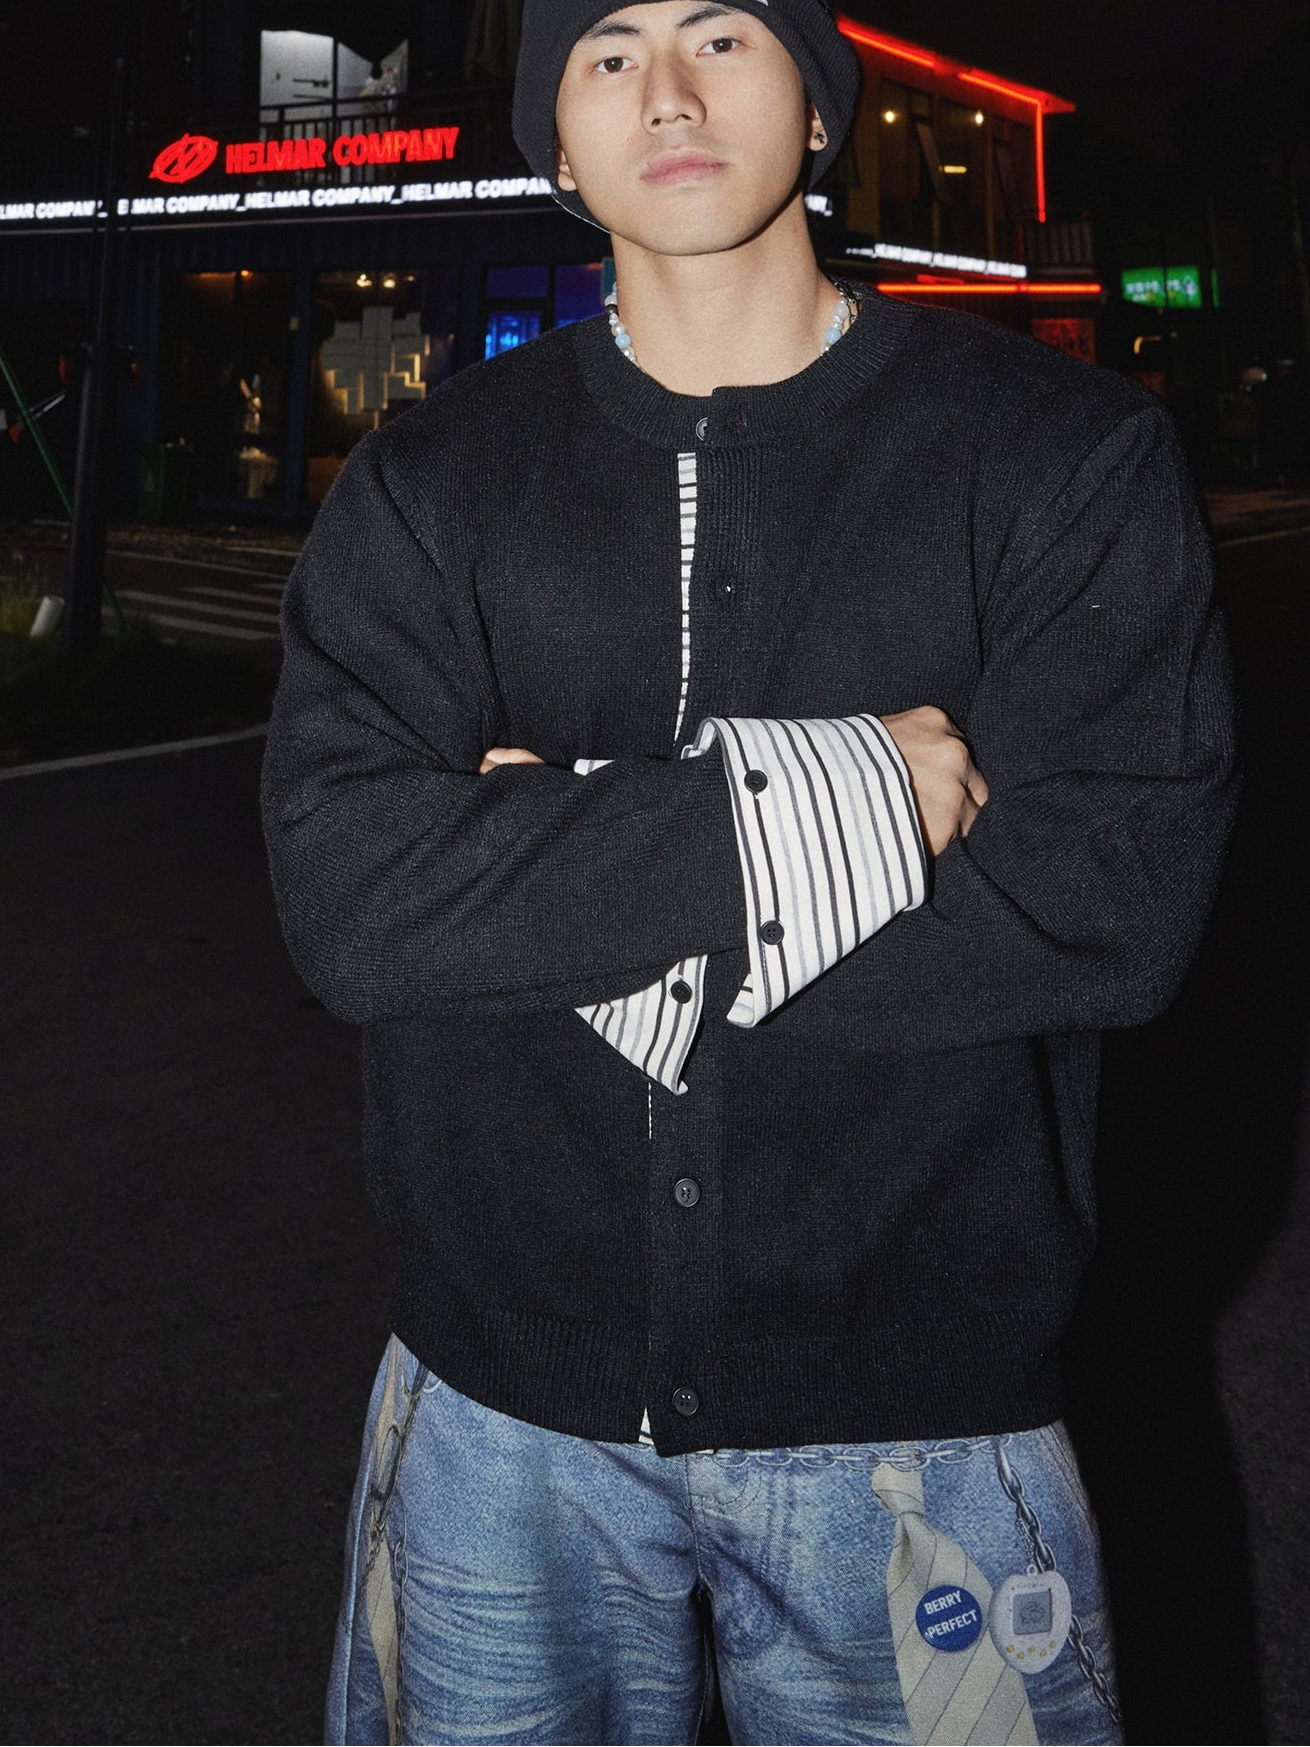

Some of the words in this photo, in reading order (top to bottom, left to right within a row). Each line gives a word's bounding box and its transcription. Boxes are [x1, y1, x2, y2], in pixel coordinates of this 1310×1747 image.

[226, 139, 326, 174] HELMAR
[333, 127, 459, 166] COMPANY
[923, 1590, 962, 1615] BERRY
[927, 1609, 978, 1639] PERFECT
